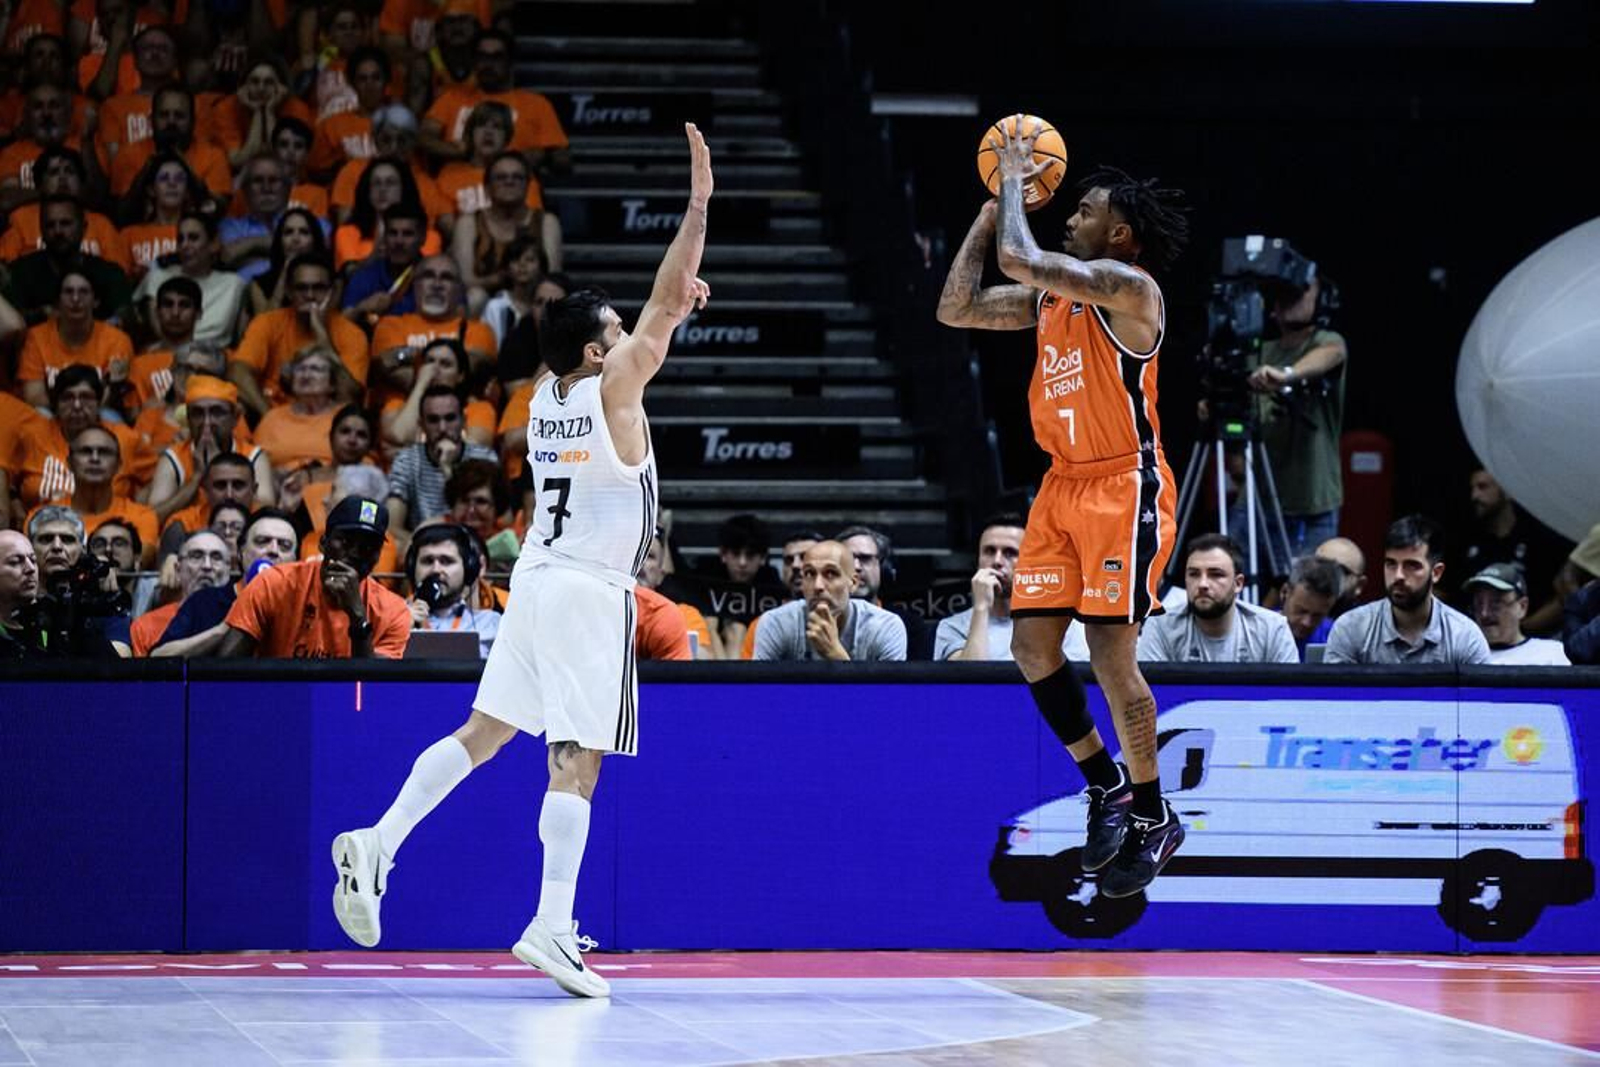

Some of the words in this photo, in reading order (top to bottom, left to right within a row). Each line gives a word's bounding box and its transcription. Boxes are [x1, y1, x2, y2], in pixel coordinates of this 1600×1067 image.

[570, 94, 652, 124] Torres
[1042, 344, 1083, 380] Roig
[1044, 376, 1085, 401] ARENA
[1058, 408, 1075, 446] 7
[534, 450, 591, 463] UTOHERO
[700, 428, 794, 462] Torres
[542, 478, 572, 547] 7
[1015, 572, 1059, 585] PULEVA
[709, 588, 777, 614] Vale
